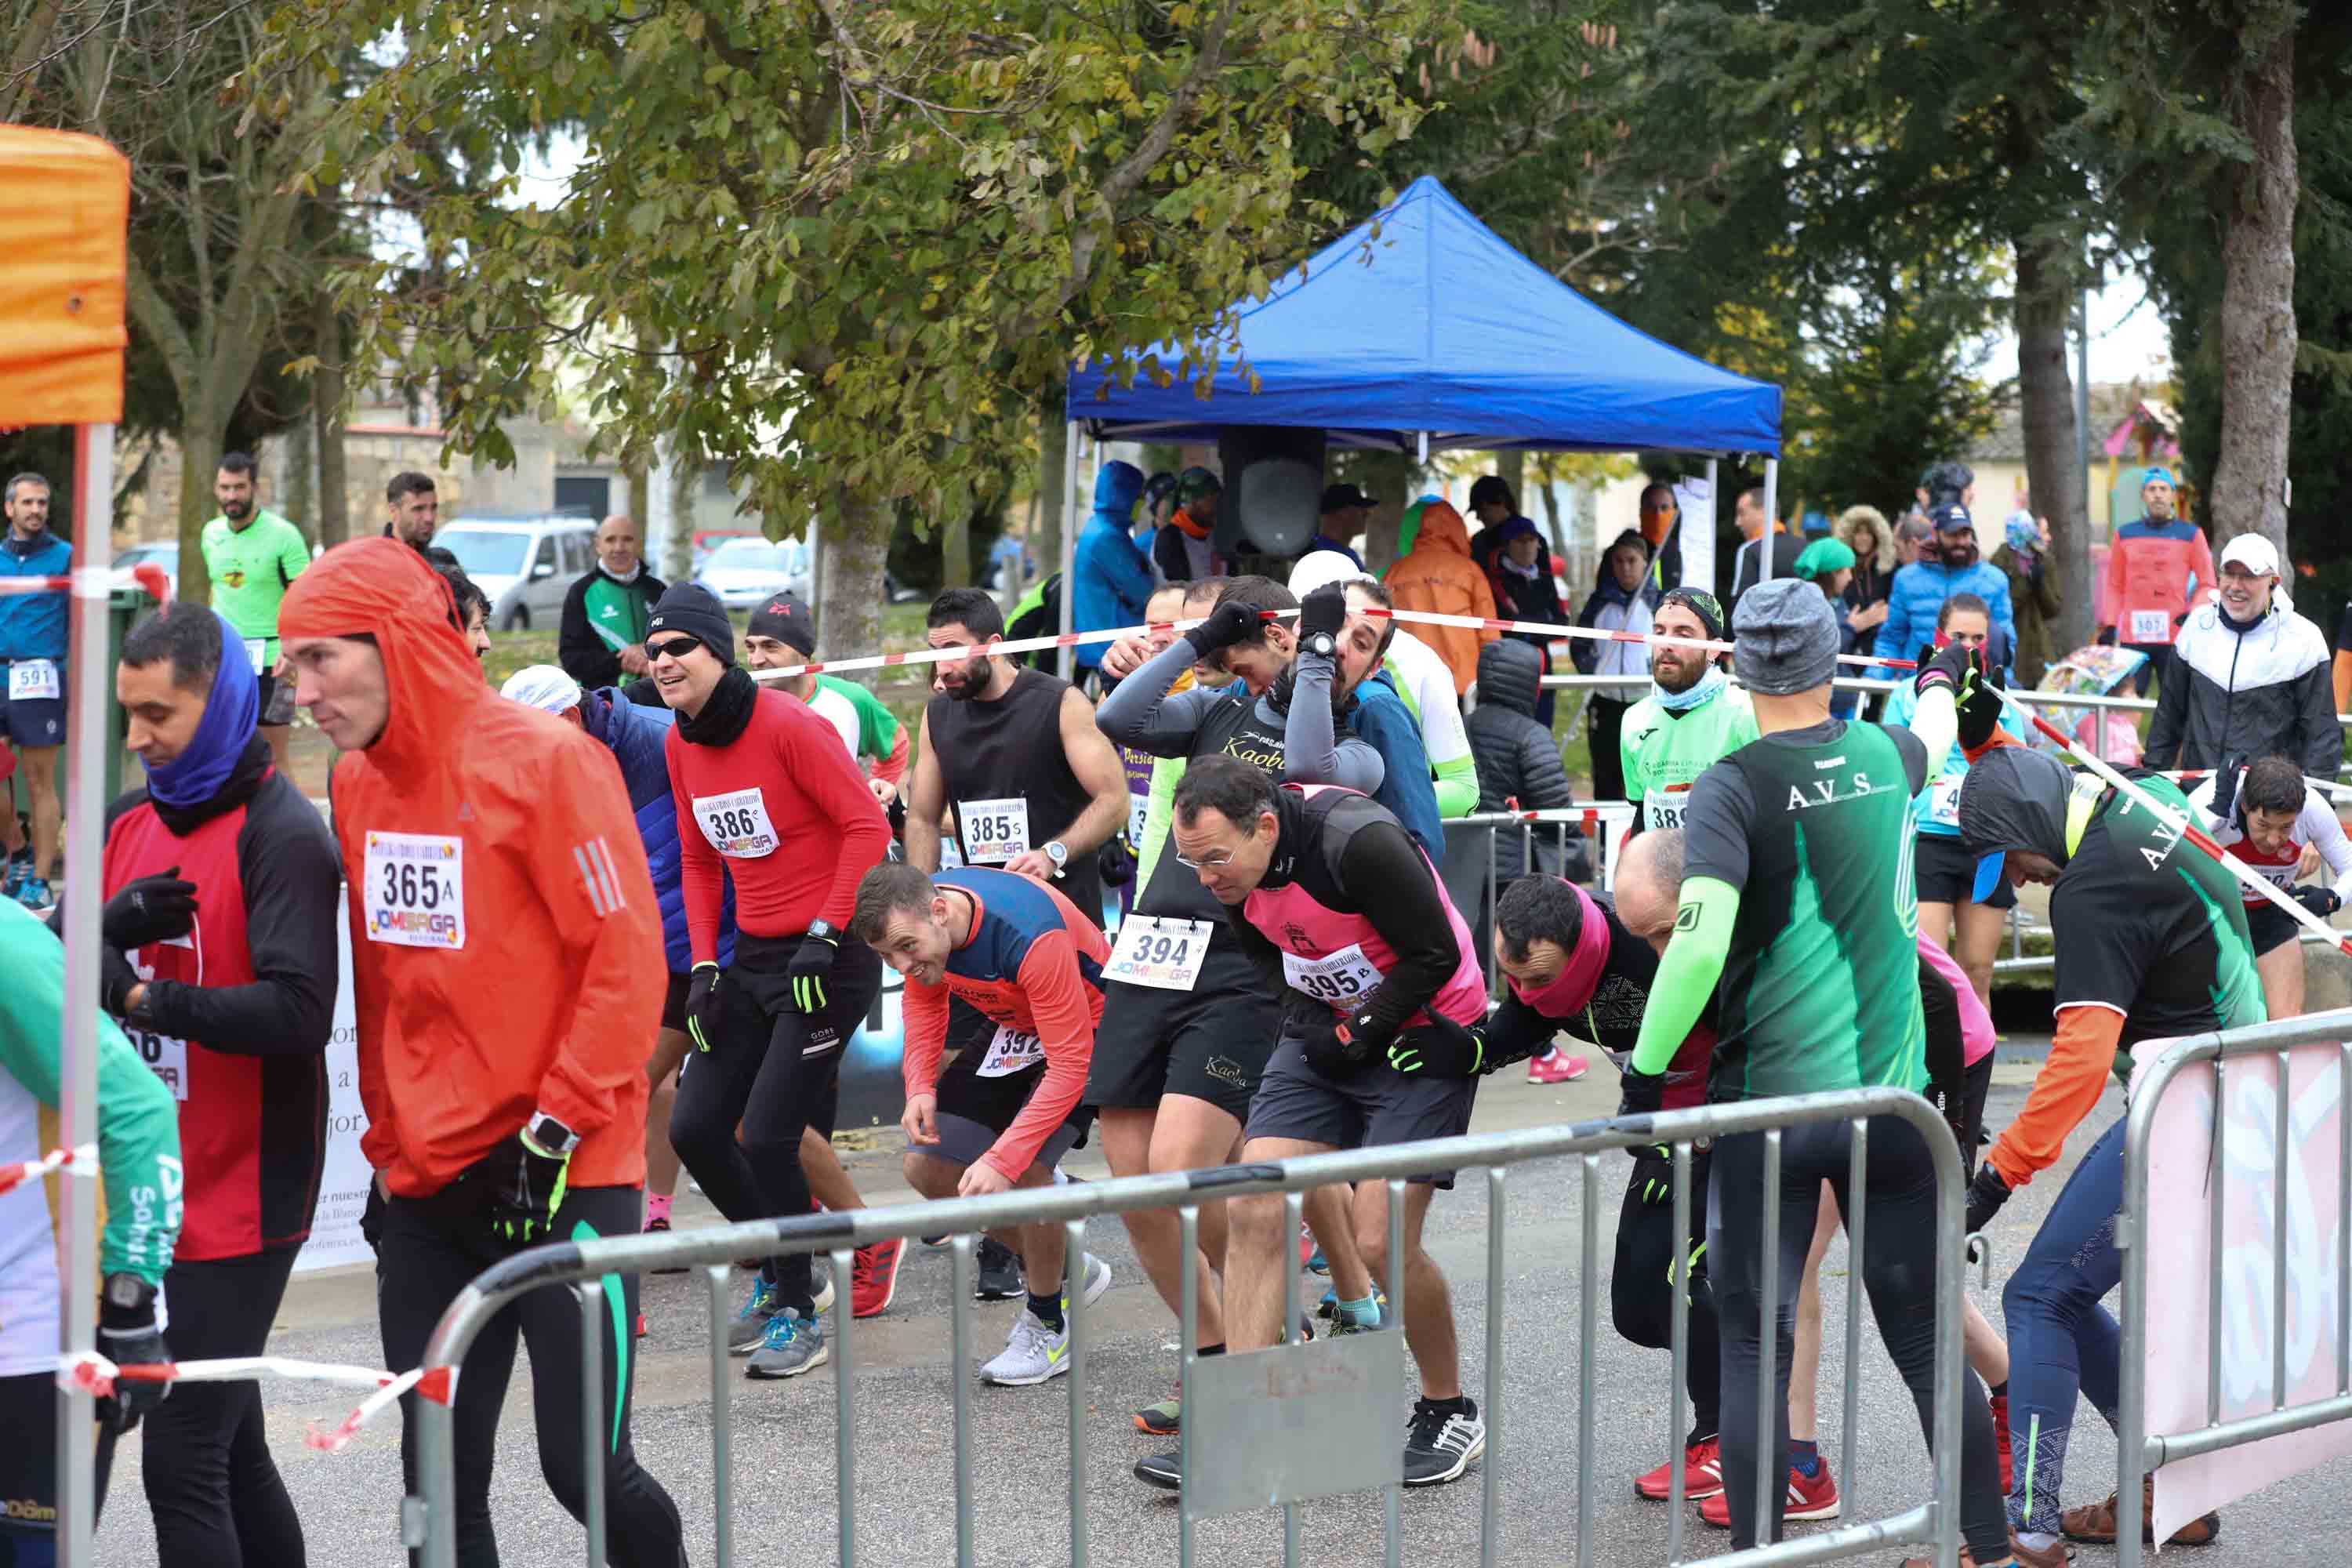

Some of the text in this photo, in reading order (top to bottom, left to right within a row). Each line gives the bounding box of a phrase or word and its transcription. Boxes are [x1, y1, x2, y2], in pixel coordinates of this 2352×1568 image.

[20, 670, 49, 684] 591
[710, 808, 754, 840] 386
[972, 815, 1011, 843] 385
[383, 862, 454, 909] 365 A
[1132, 935, 1189, 966] 394
[1300, 967, 1370, 997] 395 B
[810, 1027, 835, 1040] GORE
[1000, 1029, 1041, 1055] 392
